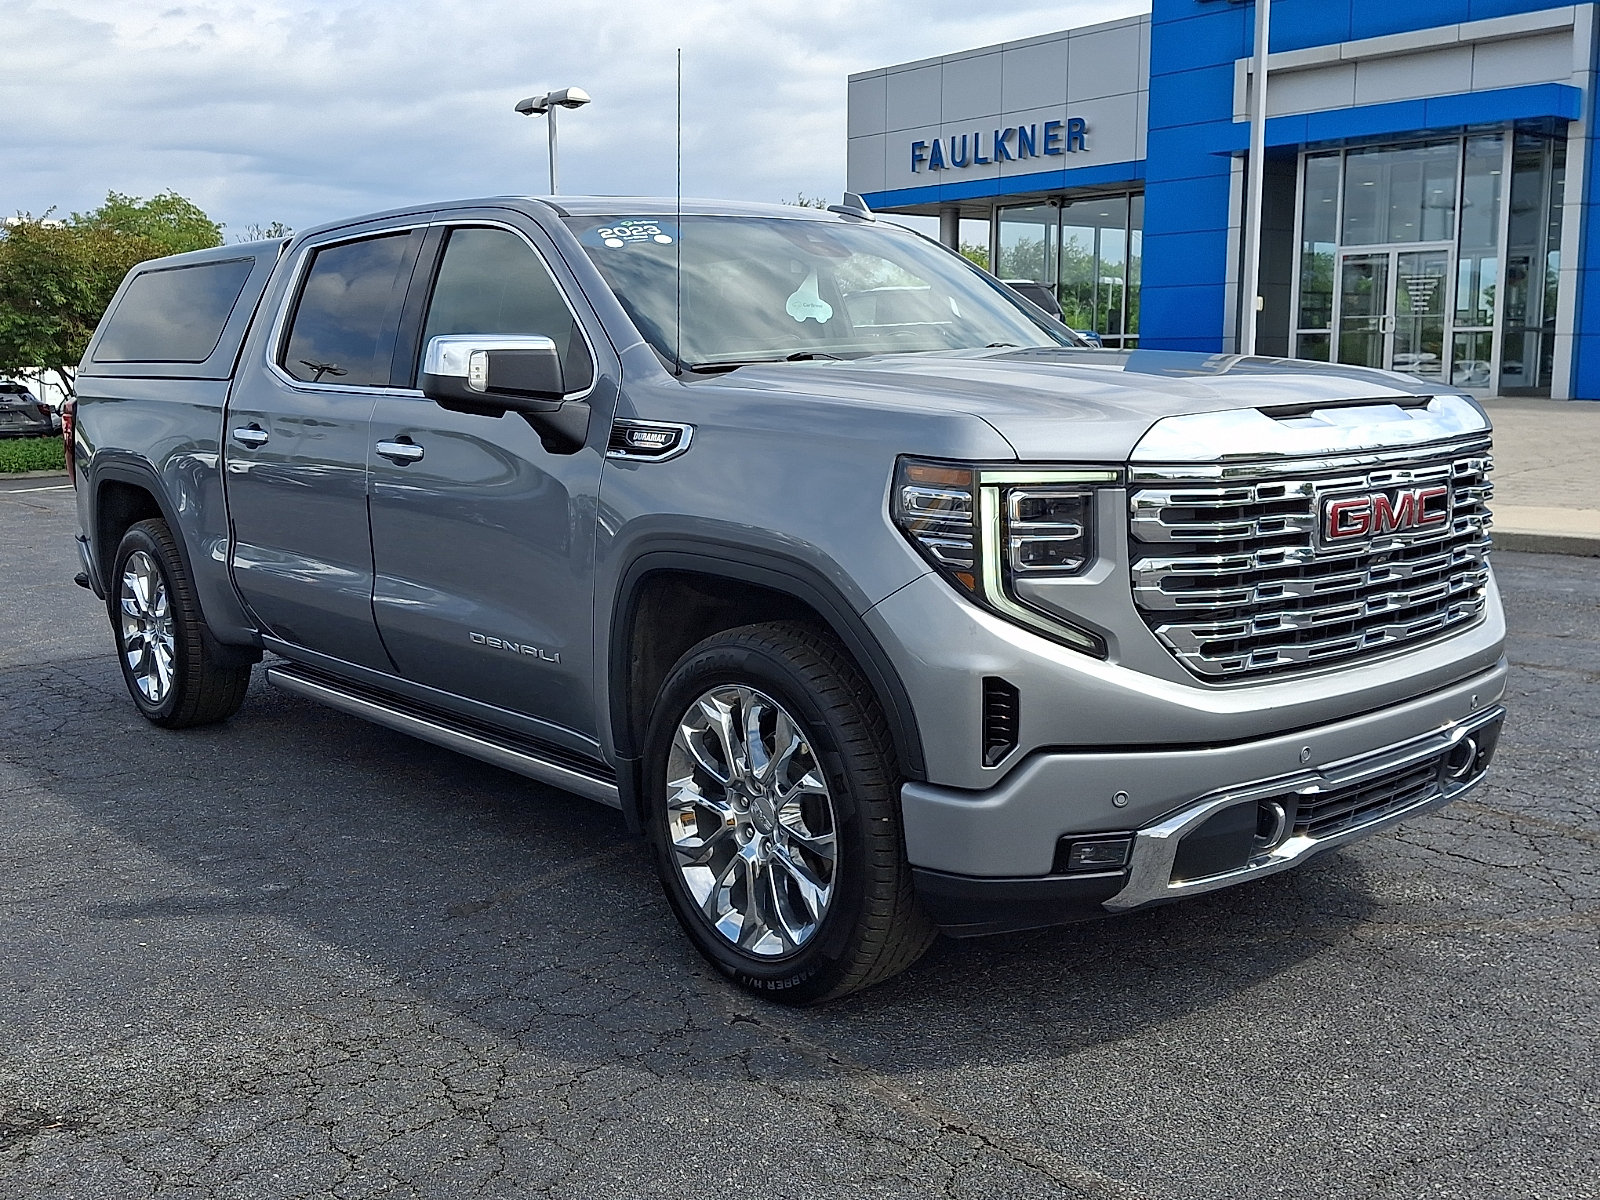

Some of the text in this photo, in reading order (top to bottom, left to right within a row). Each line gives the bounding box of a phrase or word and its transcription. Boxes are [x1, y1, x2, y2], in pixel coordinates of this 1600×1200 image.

[911, 117, 1089, 173] FAULKNER
[597, 224, 662, 239] 2023
[633, 432, 666, 442] DURAMAX
[1327, 485, 1448, 541] GMC
[469, 631, 561, 664] DENALI
